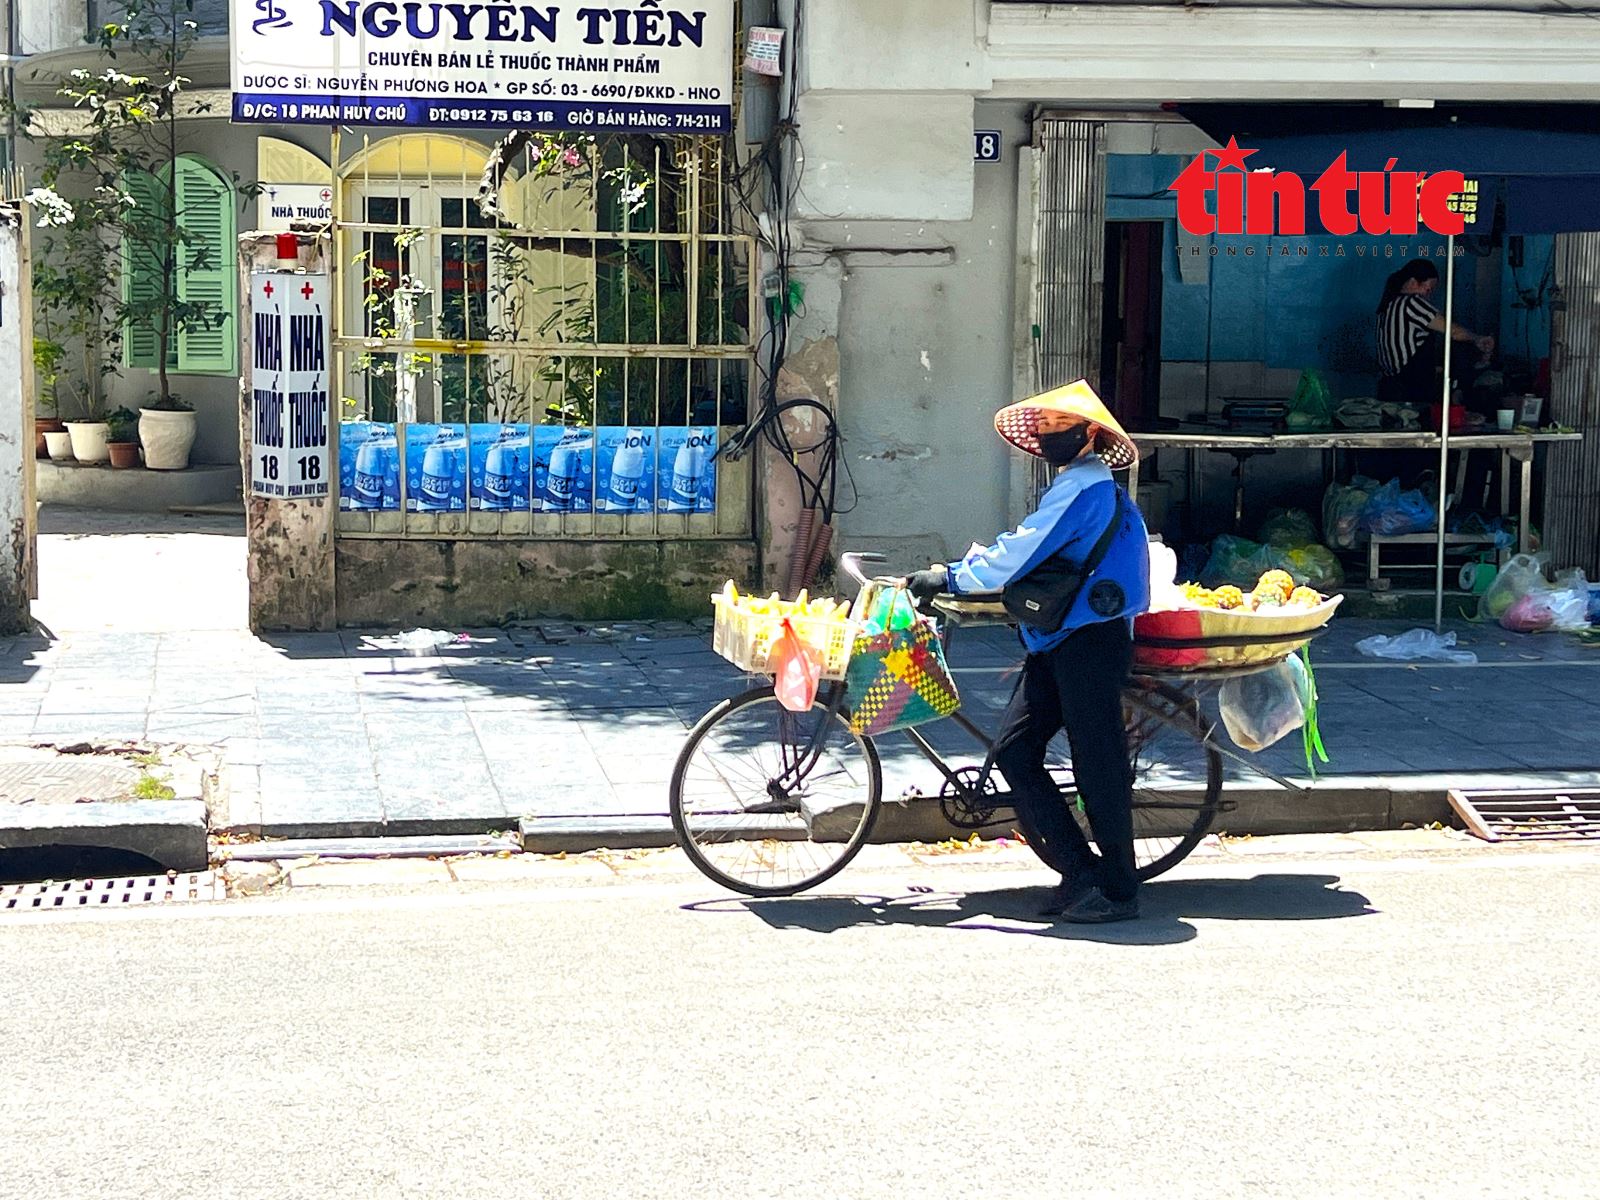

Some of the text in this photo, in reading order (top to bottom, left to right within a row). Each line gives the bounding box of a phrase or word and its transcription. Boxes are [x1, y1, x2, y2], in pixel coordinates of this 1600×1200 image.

[368, 50, 660, 73] CHUYÊN BÁN LẺ THUỐC THÀNH PHẨM
[317, 73, 378, 91] NGUYỄN
[384, 78, 449, 93] PHƯƠNG
[454, 81, 488, 94] HOA
[506, 82, 528, 95] GP
[532, 77, 557, 95] SỐ:
[561, 84, 578, 96] 03
[591, 84, 675, 99] 6690/ĐKKD
[688, 87, 721, 100] HNO
[243, 103, 406, 121] Đ/C: 18 PHAN HUY CHÚ
[429, 108, 554, 123] ĐT:0912 75 63 16
[567, 108, 721, 128] GIỜ BÁN HÀNG: 7H-21H
[271, 203, 332, 219] NHÀ THUỐC
[254, 303, 283, 372] NHÀ
[290, 303, 325, 372] NHÀ
[253, 373, 284, 449] THUỐC
[288, 372, 327, 449] THUỐC
[625, 435, 651, 449] ION
[686, 434, 713, 449] ION
[260, 454, 279, 480] 18
[297, 455, 321, 480] 18
